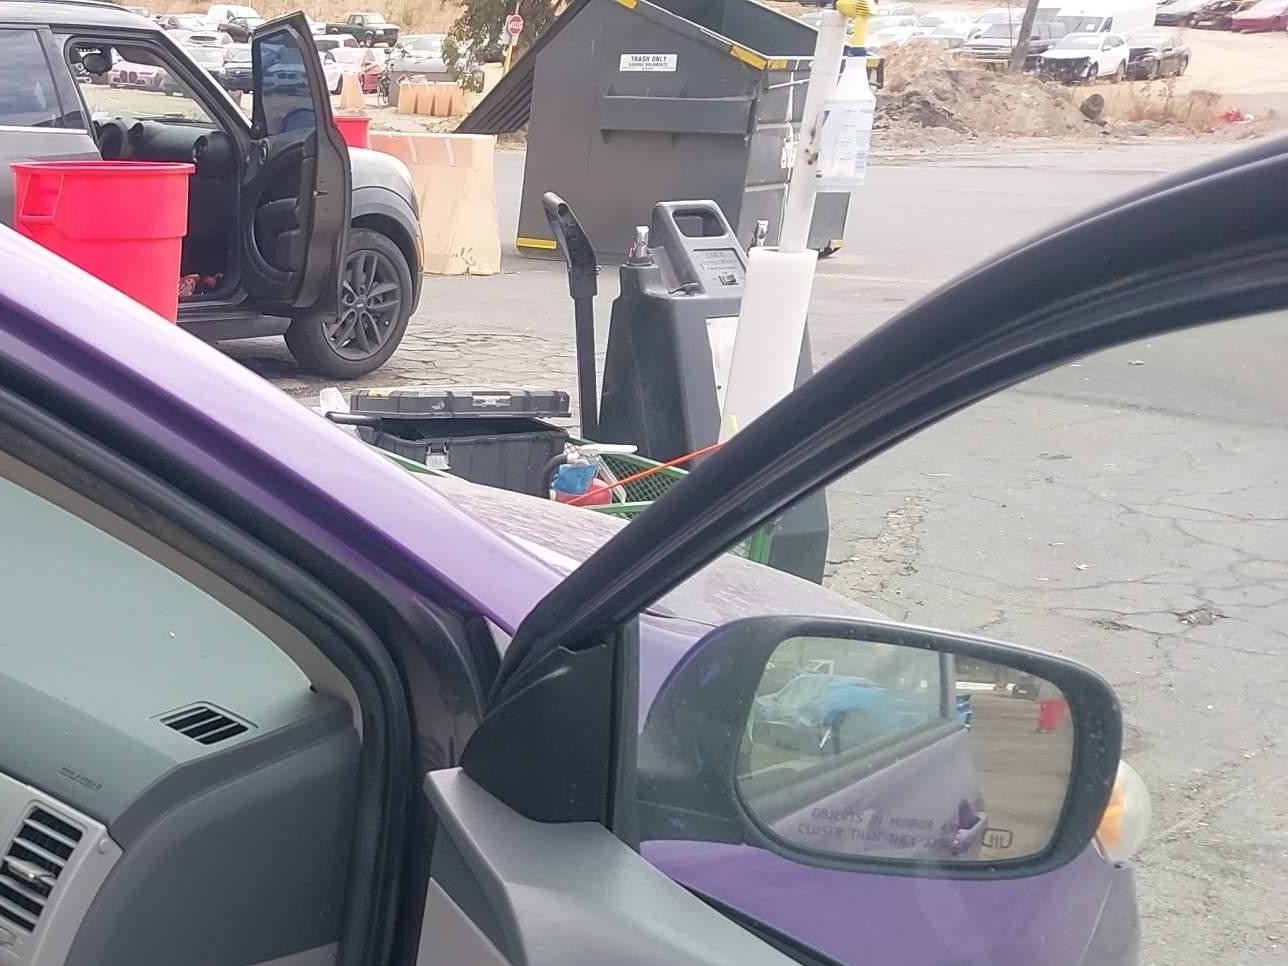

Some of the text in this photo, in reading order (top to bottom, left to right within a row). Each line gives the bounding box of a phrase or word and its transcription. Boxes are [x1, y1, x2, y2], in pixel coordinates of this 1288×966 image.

[812, 807, 865, 823] OBJECTS
[870, 814, 883, 826] IN
[890, 816, 934, 832] MIRROR
[797, 823, 843, 839] CLOSER
[850, 828, 881, 842] THAN
[888, 832, 917, 847] THEY
